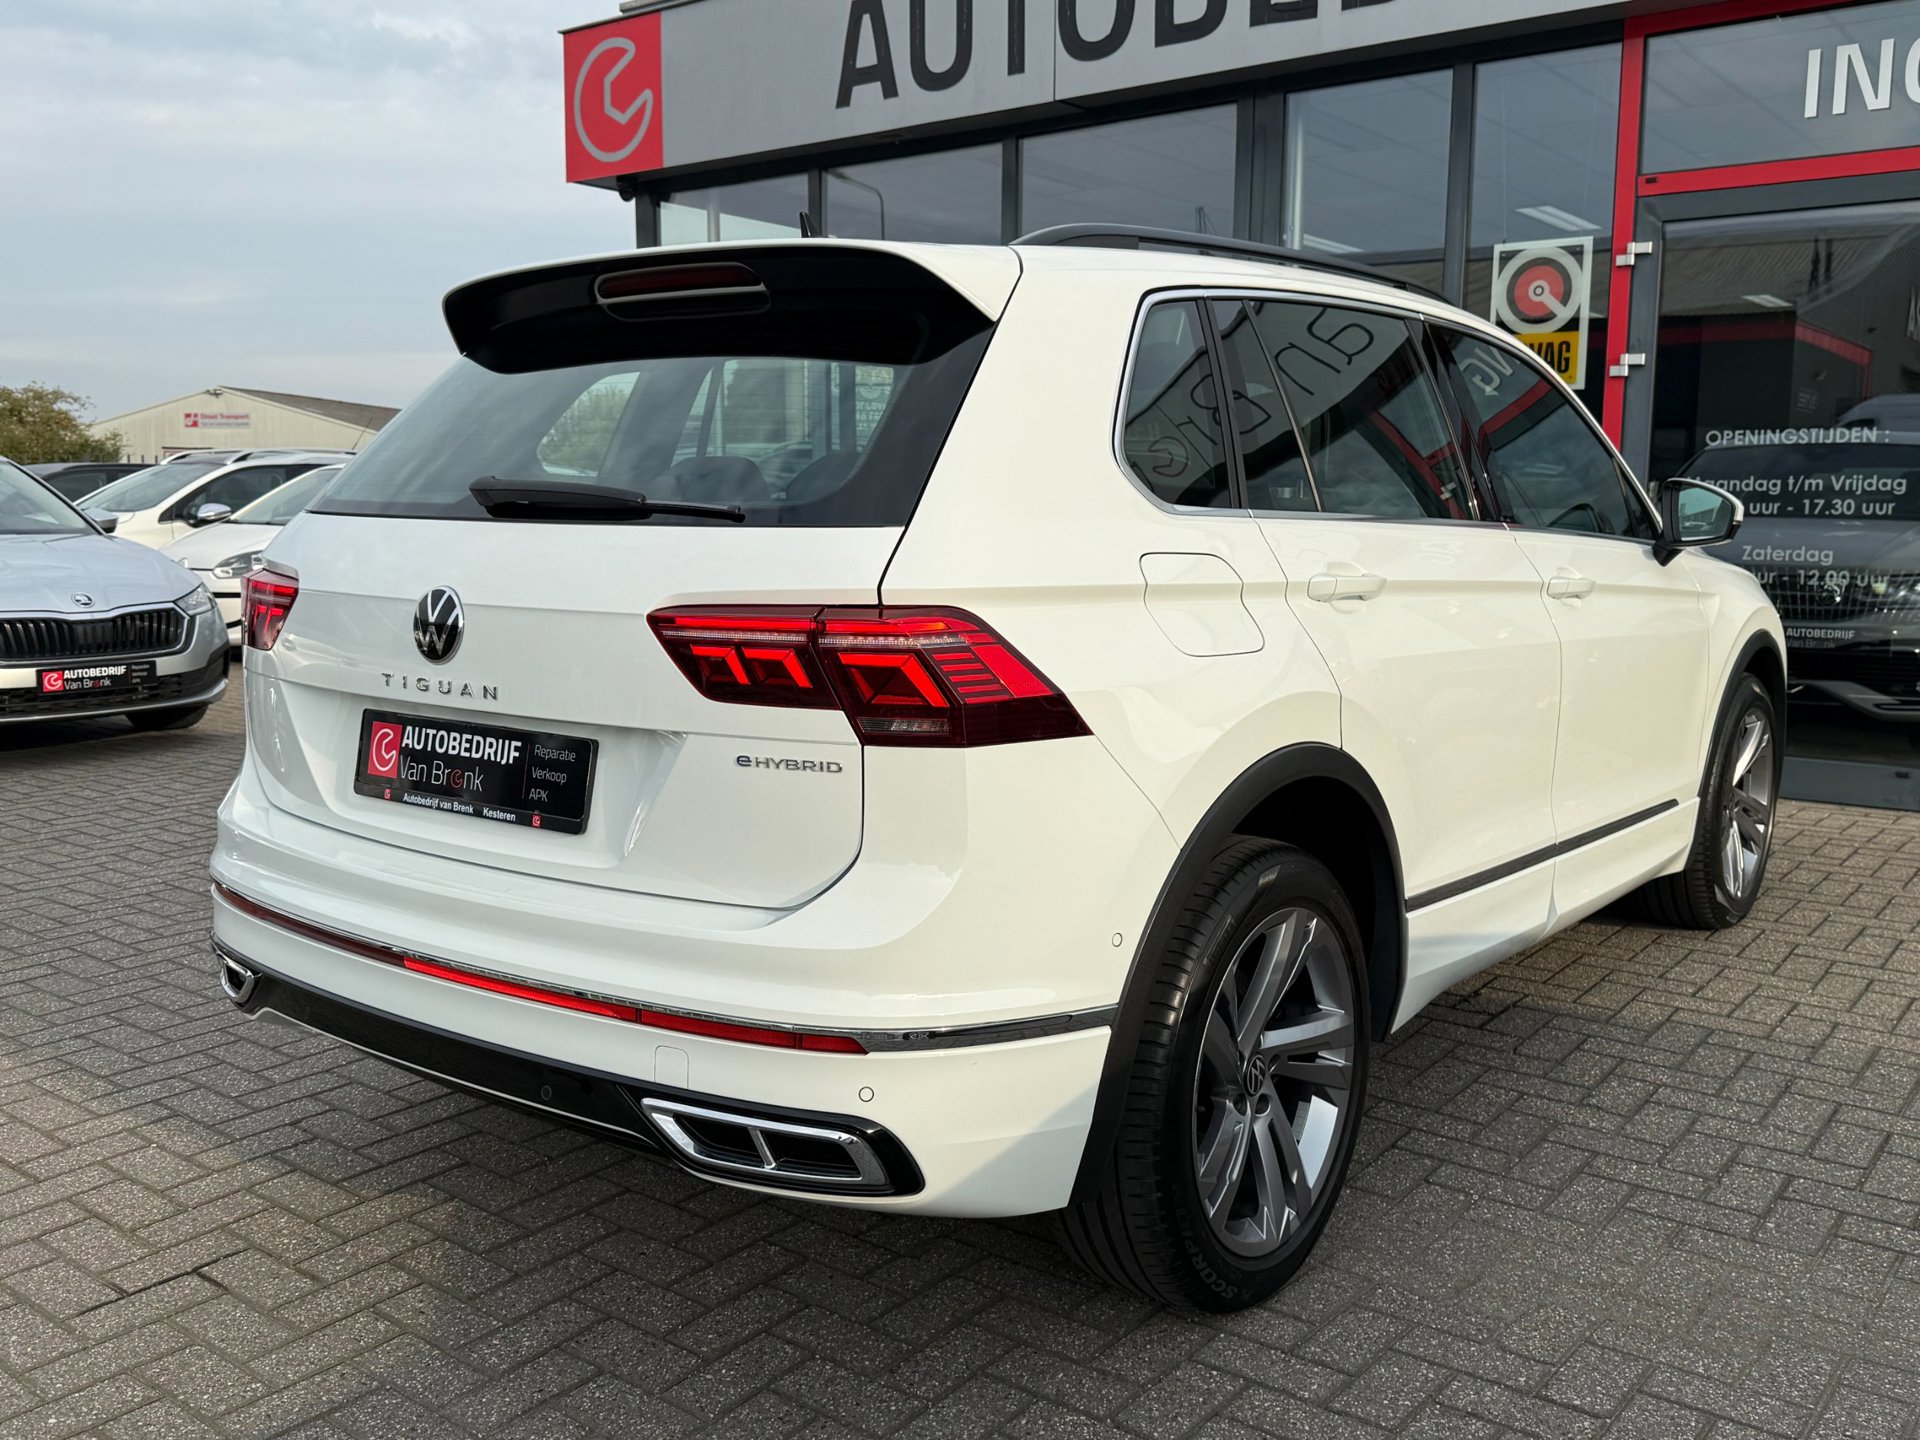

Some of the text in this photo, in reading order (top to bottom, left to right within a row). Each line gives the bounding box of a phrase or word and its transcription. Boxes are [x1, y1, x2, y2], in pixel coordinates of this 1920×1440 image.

[1705, 426, 1878, 446] OPENINGSTIJDEN
[1787, 475, 1823, 494] t/m
[1831, 474, 1907, 496] Vrijdag
[1749, 502, 1781, 515] uur
[1803, 499, 1855, 515] 17.30
[1862, 502, 1896, 515] uur
[1742, 545, 1834, 566] Zaterdag
[1752, 570, 1776, 585] ur
[1786, 628, 1856, 640] AUTOBEDRIJF
[63, 665, 127, 680] AUTOBEDRIJF
[64, 680, 82, 690] Van
[381, 672, 499, 701] TIGUAN
[401, 725, 577, 765] AUTOBEDRIJF Reparatie
[400, 754, 428, 783] Van
[531, 766, 567, 786] Verkoop
[528, 788, 549, 802] APK
[403, 792, 517, 822] Autobedrijf van Brenk Kesteren
